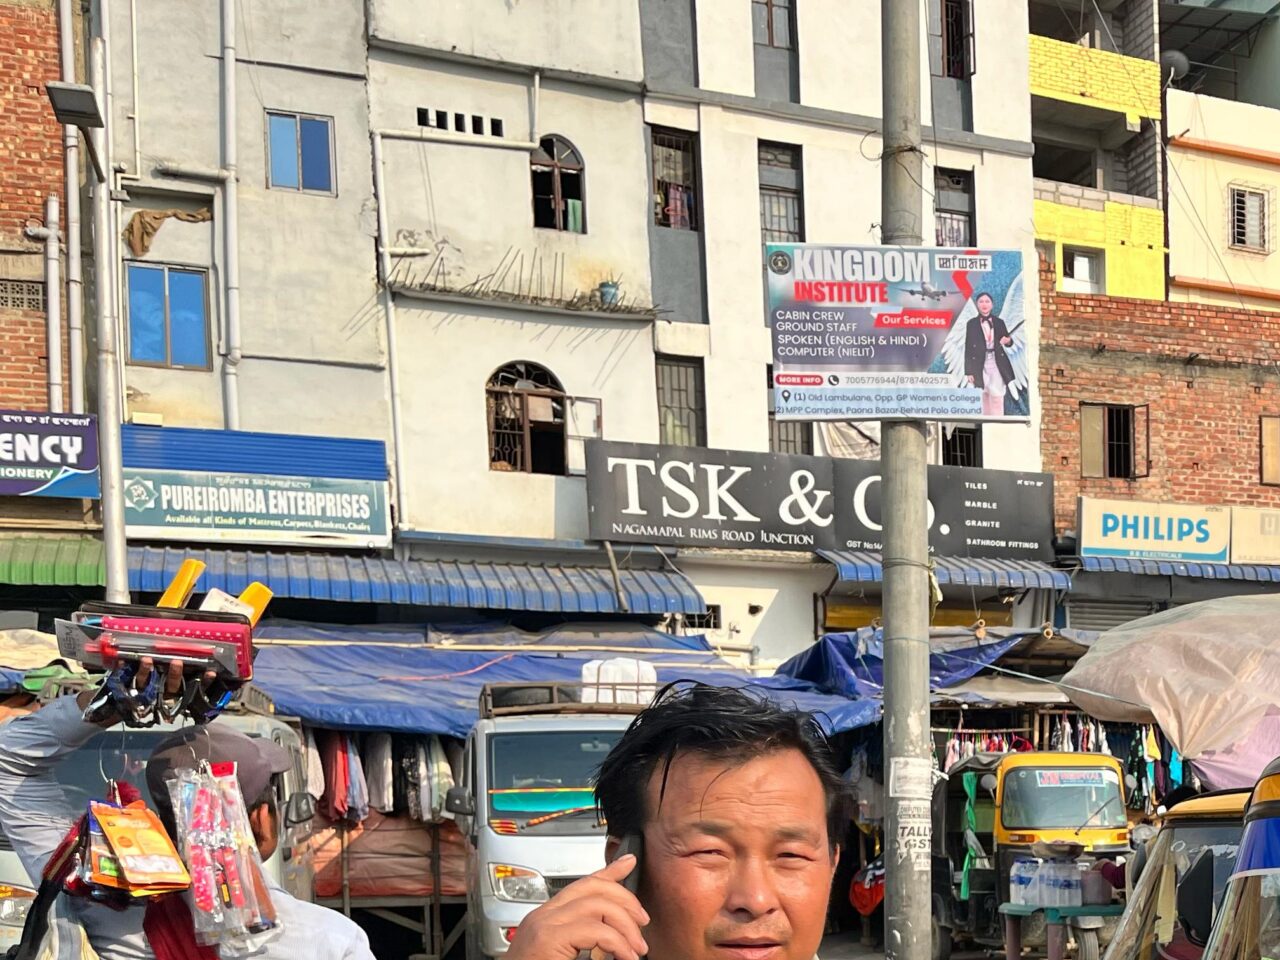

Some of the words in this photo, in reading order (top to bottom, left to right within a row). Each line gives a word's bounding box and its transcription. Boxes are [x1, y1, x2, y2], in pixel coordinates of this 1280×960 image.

[794, 249, 930, 283] KINGDOM
[794, 281, 889, 304] INSTITUTE
[776, 310, 810, 321] CABIN
[812, 311, 845, 321] CREW
[882, 315, 901, 325] Our
[903, 315, 946, 326] Services
[776, 322, 824, 332] GROUND
[826, 322, 857, 332] STAFF
[777, 334, 822, 345] SPOKEN
[825, 334, 876, 347] (ENGLISH
[878, 336, 887, 346] &
[777, 347, 835, 357] COMPUTER
[837, 347, 875, 358] (NIELIT)
[779, 376, 800, 384] MORE
[793, 392, 806, 402] (1)
[808, 393, 822, 401] Old
[949, 394, 980, 404] College
[786, 406, 803, 414] MPP
[846, 406, 873, 414] Paona
[931, 406, 949, 414] Polo
[950, 406, 982, 414] Ground
[964, 481, 988, 490] TILES
[607, 456, 760, 522] TSK
[779, 469, 834, 527] &
[160, 484, 267, 514] PUREIROMBA
[268, 489, 371, 519] ENTERPRISES
[964, 500, 998, 510] MARBLE
[165, 514, 201, 524] Available
[203, 515, 213, 524] all
[215, 516, 236, 525] Kinds
[238, 517, 247, 525] of
[965, 519, 1000, 529] GRANITE
[1102, 513, 1210, 543] PHILIPS
[612, 523, 684, 538] NAGAMAPAL
[690, 528, 718, 540] RIMS
[721, 529, 755, 542] ROAD
[760, 529, 815, 545] JUNCTION
[846, 540, 862, 549] GST
[966, 538, 1006, 548] BATHROOM
[1008, 539, 1039, 550] FITTINGS
